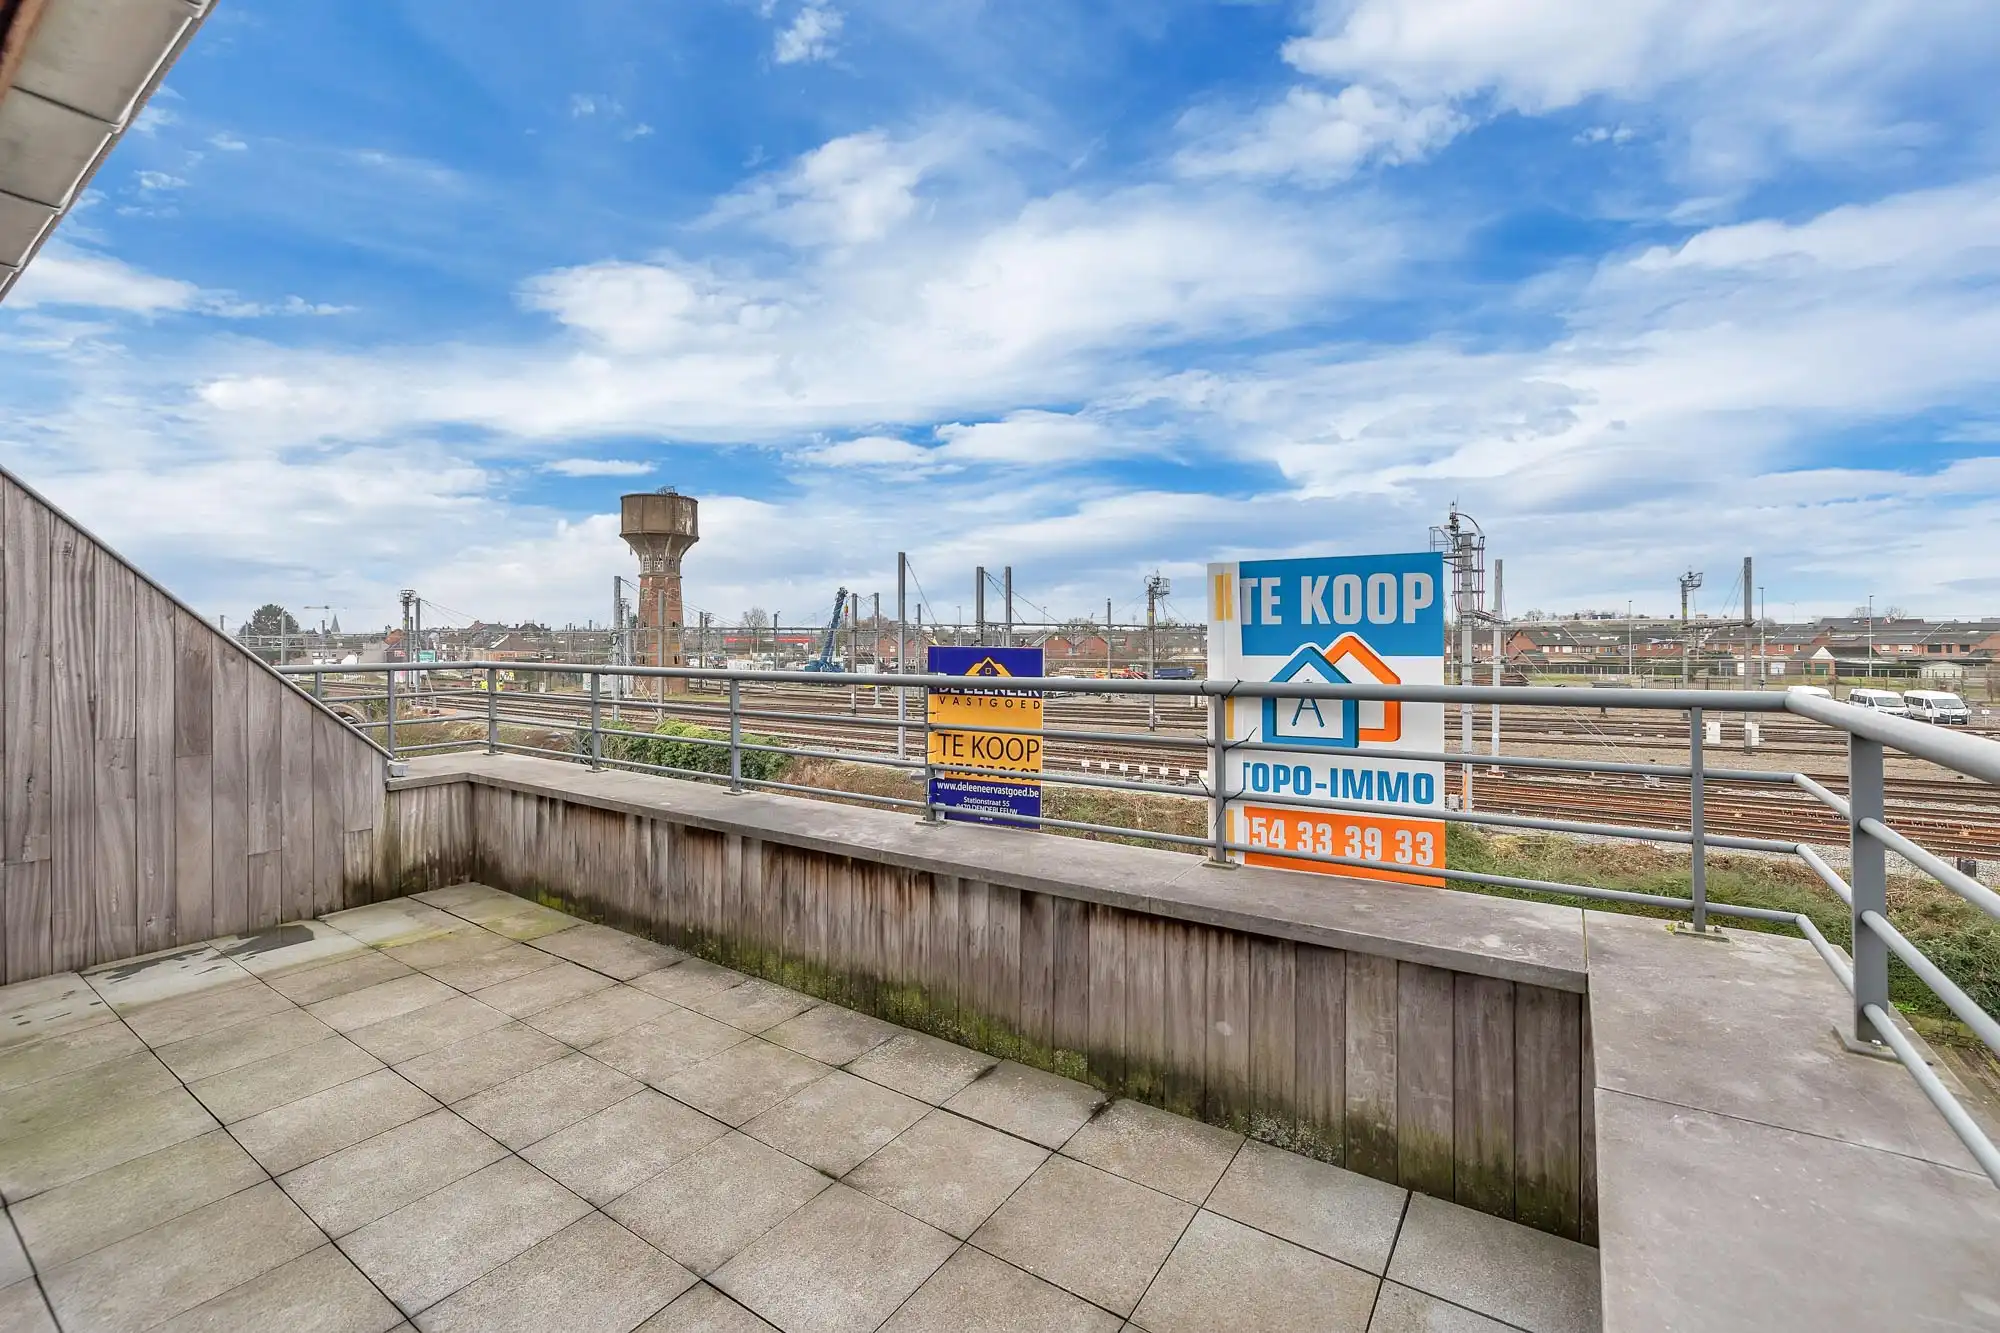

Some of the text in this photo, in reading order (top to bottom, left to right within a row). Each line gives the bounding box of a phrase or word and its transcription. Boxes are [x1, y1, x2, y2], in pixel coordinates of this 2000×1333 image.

[1240, 572, 1434, 625] TE KOOP
[939, 696, 1040, 710] VASTGOED
[937, 733, 1040, 763] TE KOOP
[937, 782, 1039, 798] www.deleeneervastgoed.be
[1297, 822, 1333, 856] 33
[1345, 826, 1382, 861] 39
[1394, 830, 1434, 866] 33
